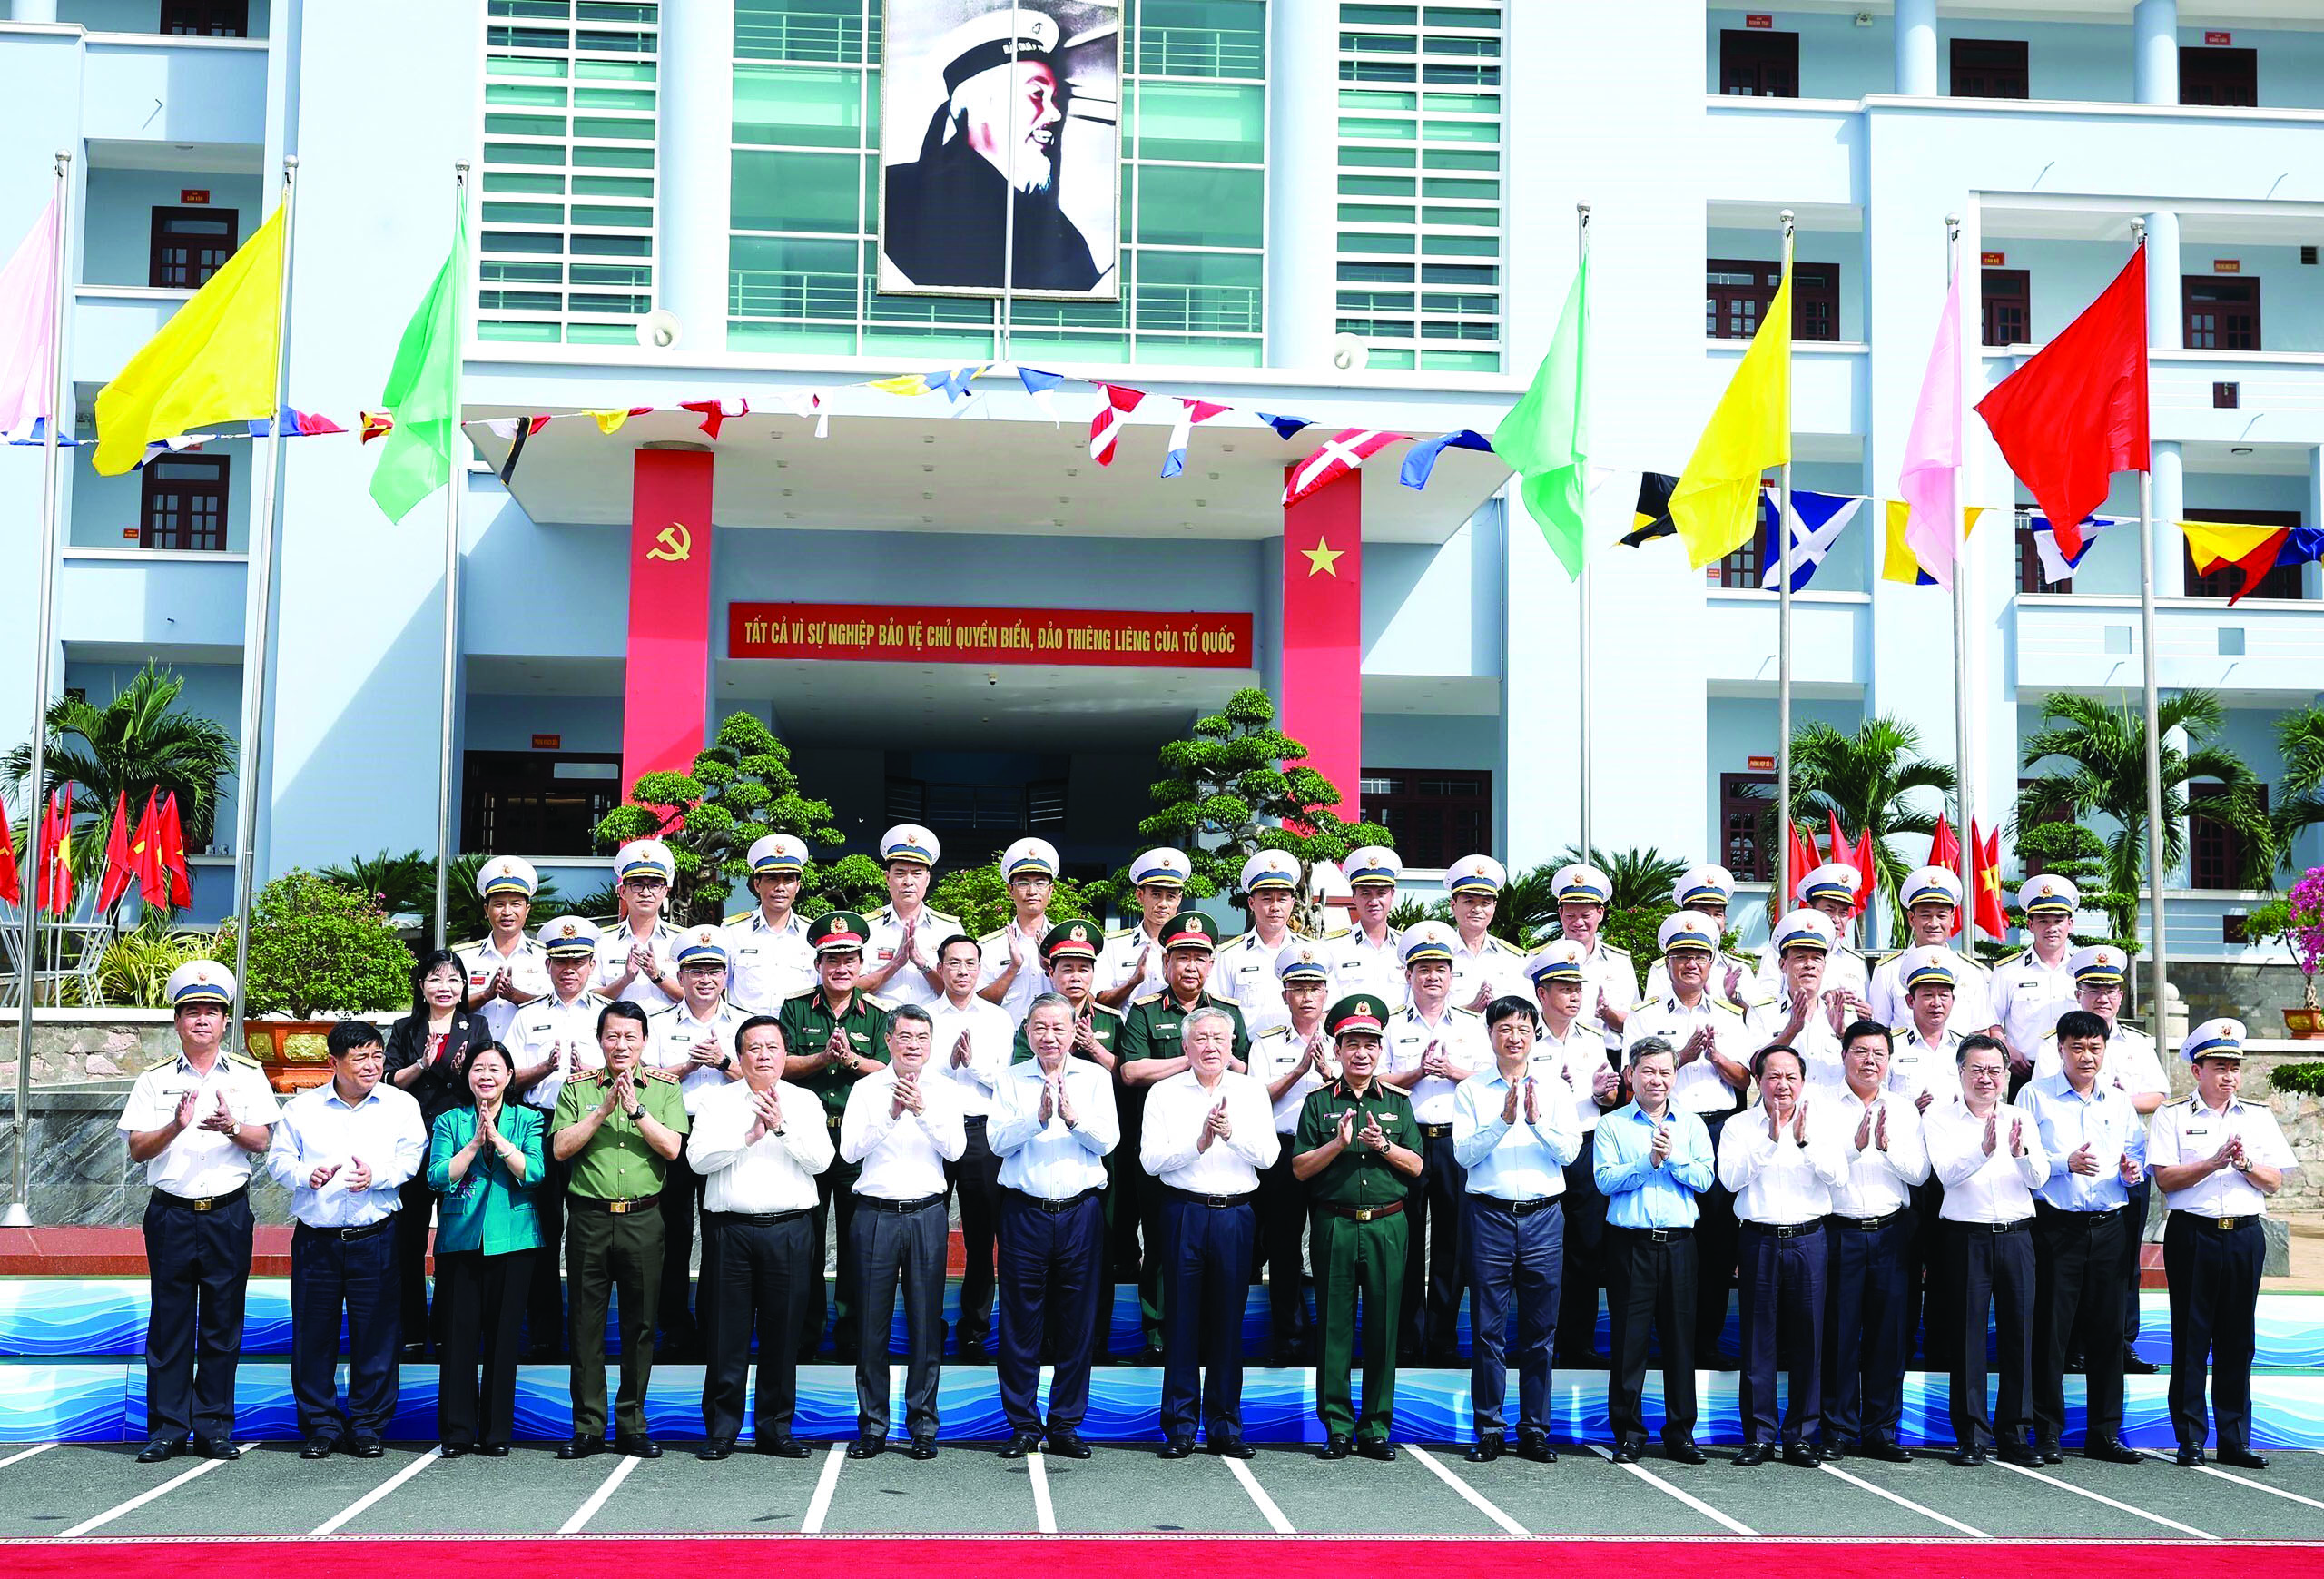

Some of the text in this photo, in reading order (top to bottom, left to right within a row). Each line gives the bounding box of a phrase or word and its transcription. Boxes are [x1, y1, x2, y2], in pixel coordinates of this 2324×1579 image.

[744, 615, 1236, 656] TẤT CẢ VÌ SỰ NGHIỆP BẢO VỆ CHỦ QUYỀN BIỂN, ĐẢO THIÊNG LIÊNG CỦA TỔ QUỐC
